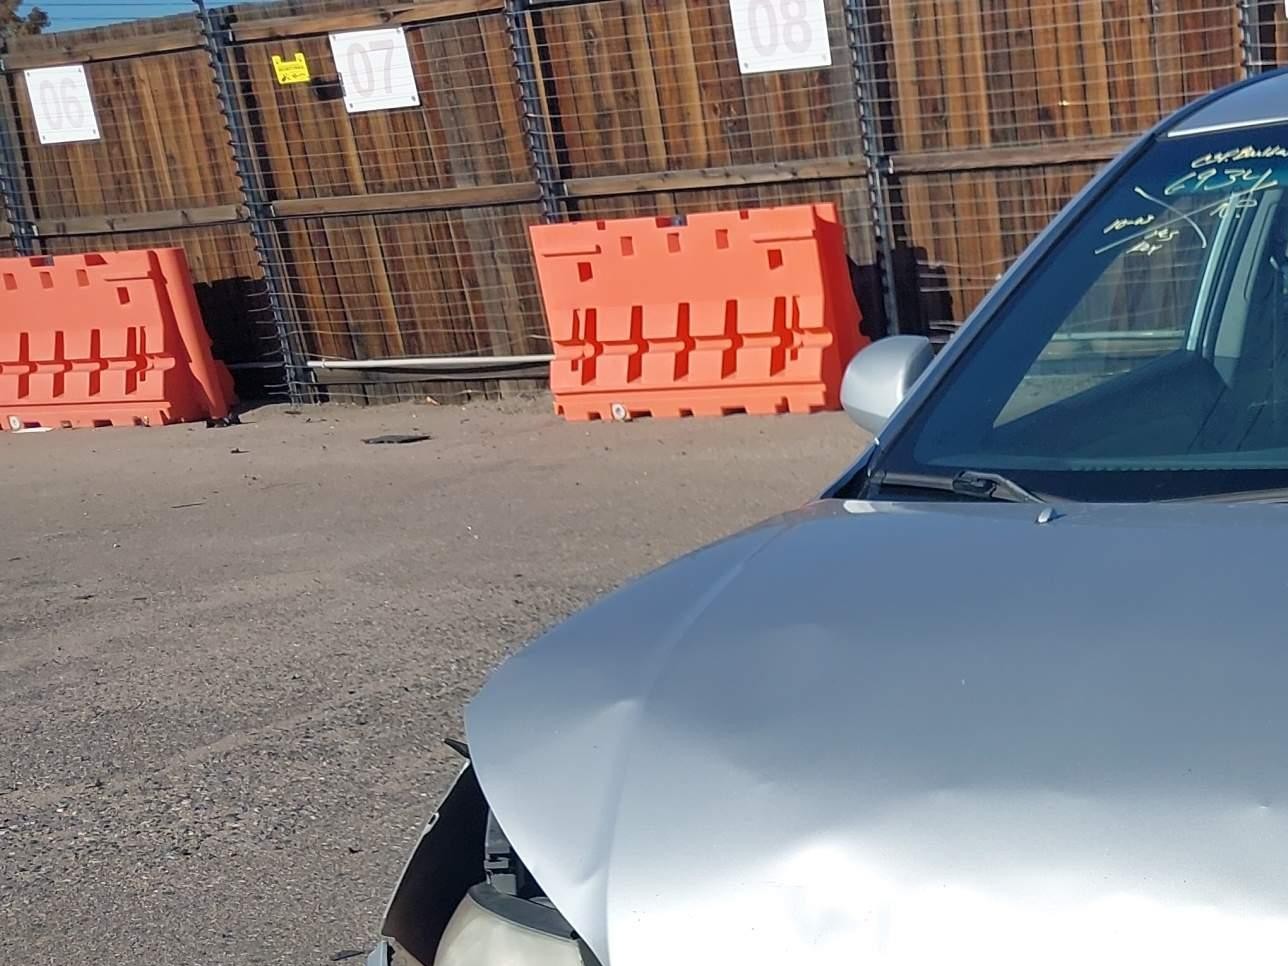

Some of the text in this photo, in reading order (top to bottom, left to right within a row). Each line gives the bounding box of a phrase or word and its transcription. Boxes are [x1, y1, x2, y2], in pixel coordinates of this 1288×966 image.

[747, 0, 813, 56] 08
[346, 39, 394, 97] 07
[39, 77, 85, 129] 06
